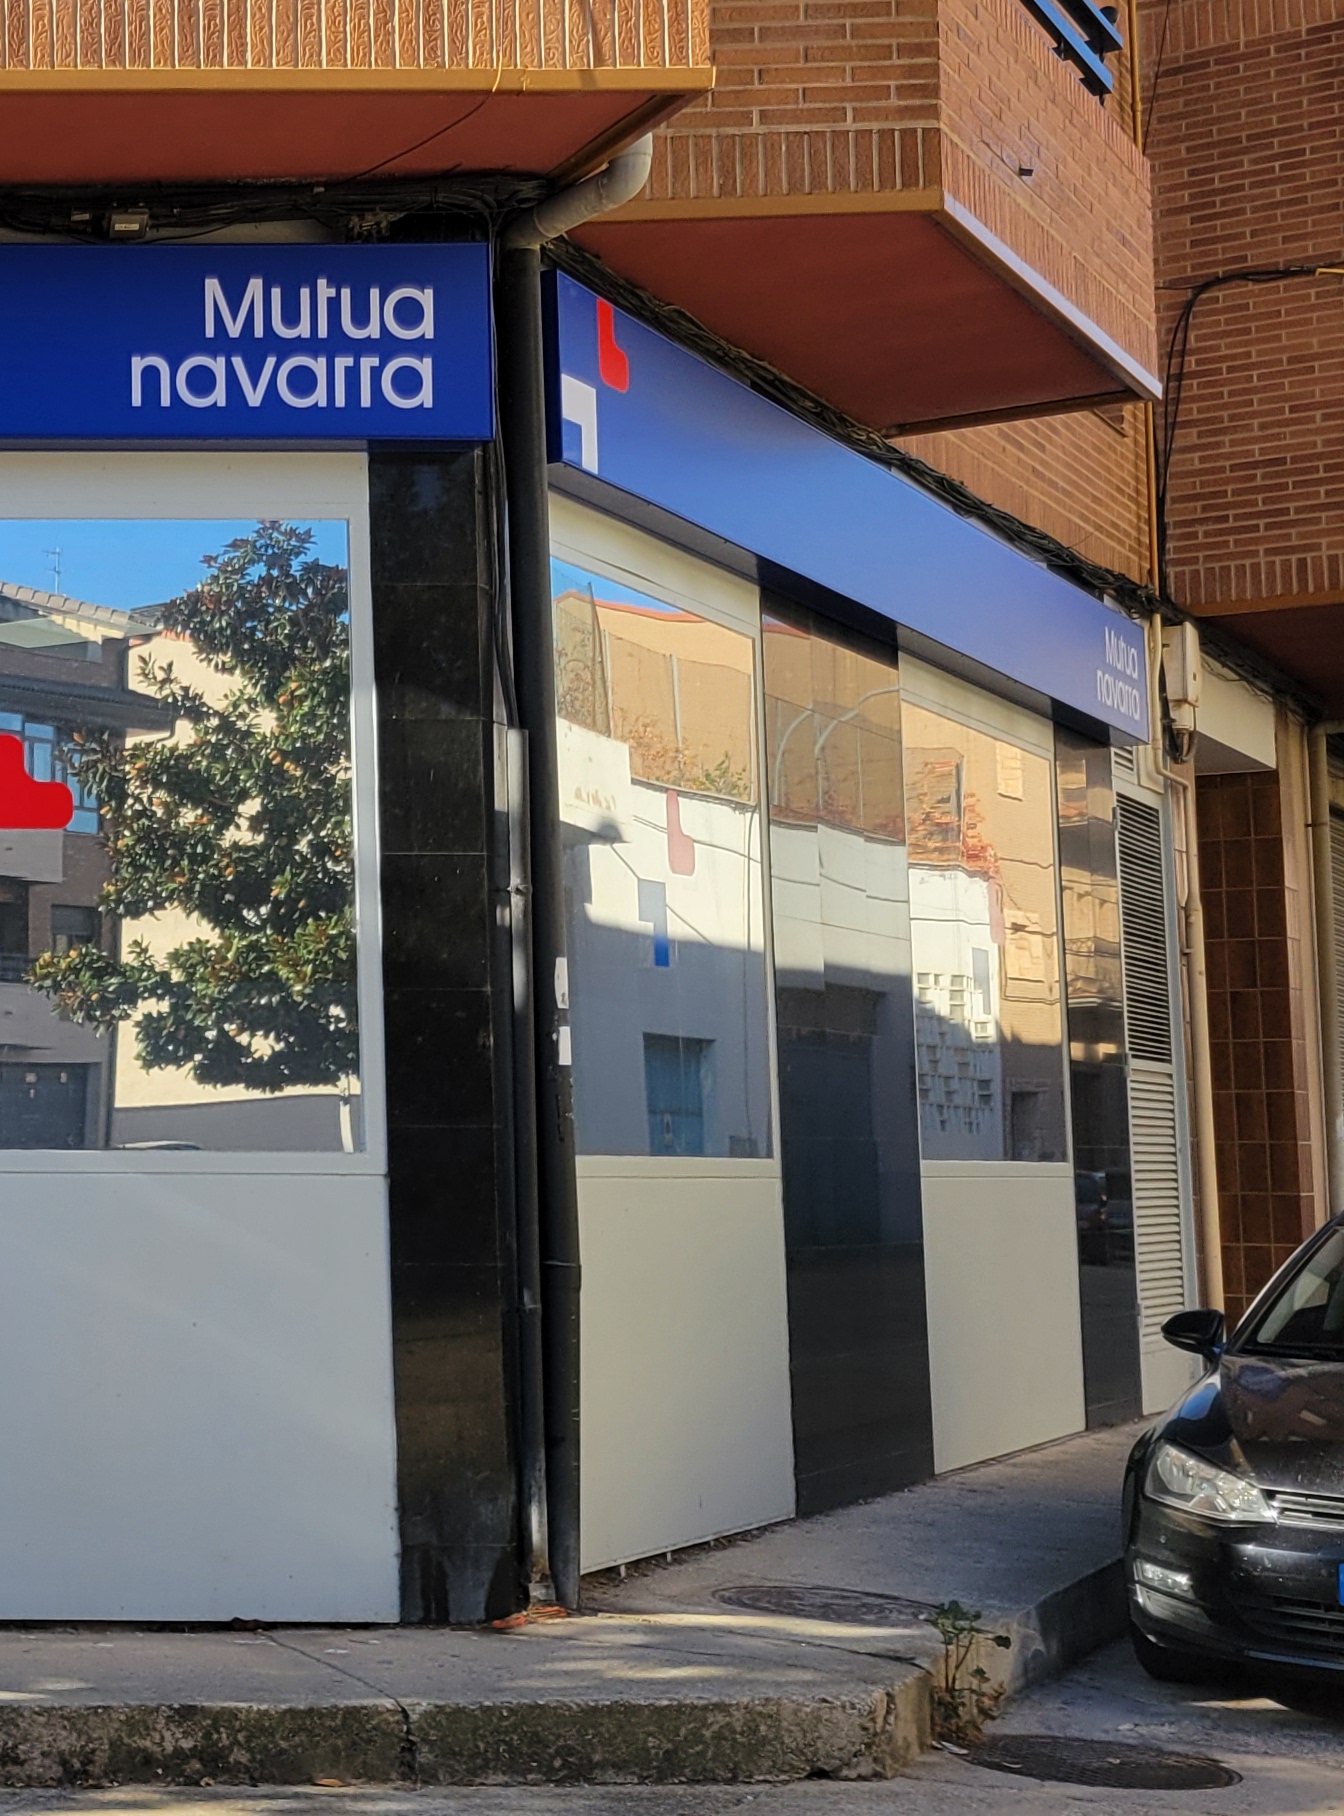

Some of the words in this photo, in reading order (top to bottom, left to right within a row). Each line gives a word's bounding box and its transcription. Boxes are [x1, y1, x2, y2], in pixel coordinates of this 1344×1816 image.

[204, 277, 434, 340] Mutua
[130, 355, 433, 409] navarra
[1105, 626, 1138, 679] Mutua
[1096, 669, 1140, 721] navarra
